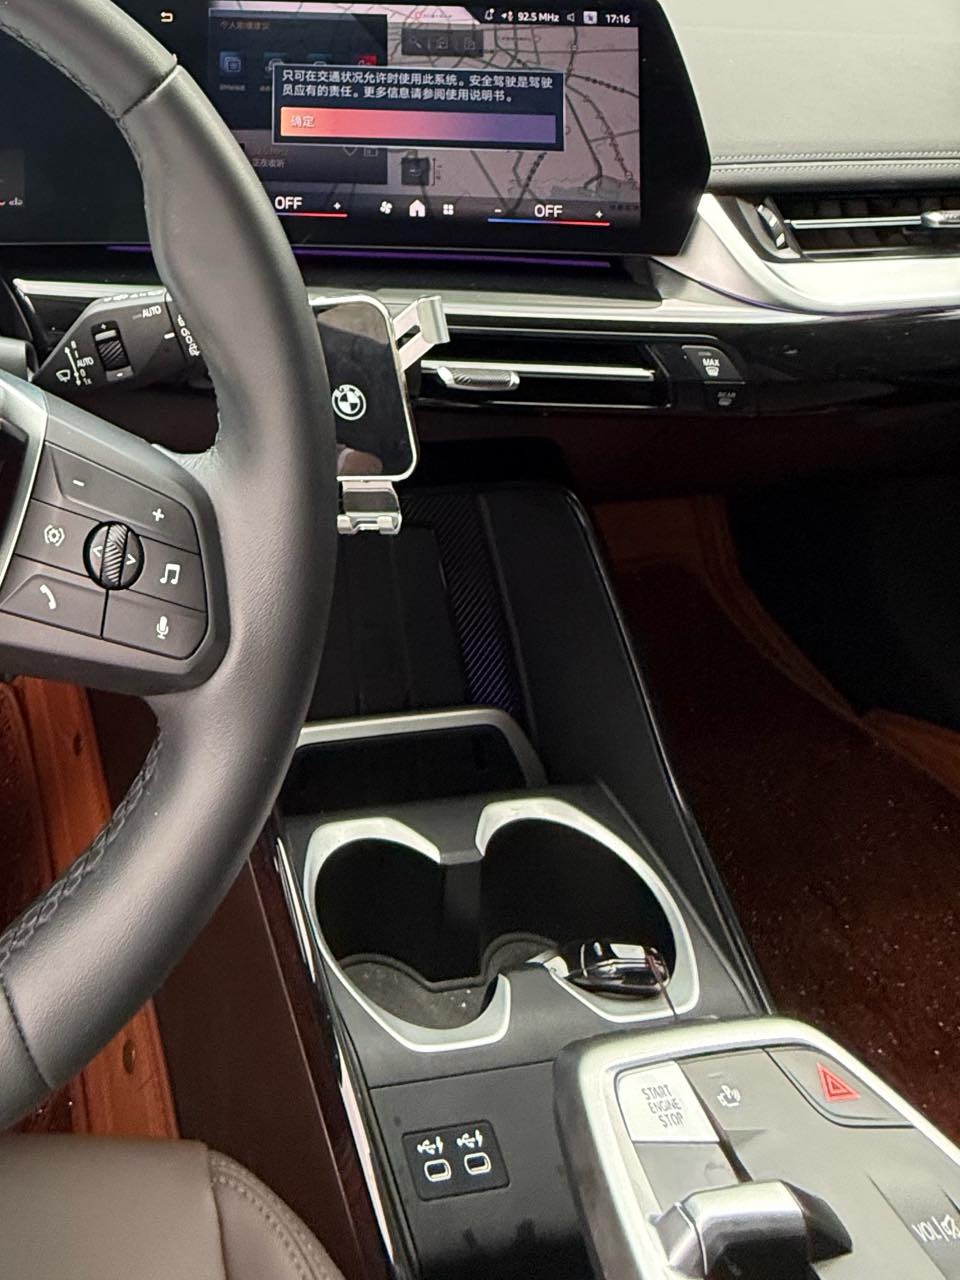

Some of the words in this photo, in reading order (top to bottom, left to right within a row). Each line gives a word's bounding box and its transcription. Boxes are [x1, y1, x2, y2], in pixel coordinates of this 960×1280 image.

[518, 11, 537, 21] 92.5
[539, 12, 560, 22] MHz
[605, 14, 631, 24] 17:16
[290, 115, 315, 128] 确定
[275, 196, 303, 210] OFF
[534, 204, 563, 218] OFF
[142, 305, 161, 318] AUTO
[76, 357, 94, 368] AUTO
[702, 358, 720, 367] MAX
[641, 1083, 673, 1101] START
[648, 1098, 682, 1113] ENGINE
[661, 1112, 685, 1128] STOP
[912, 1219, 937, 1243] VOL
